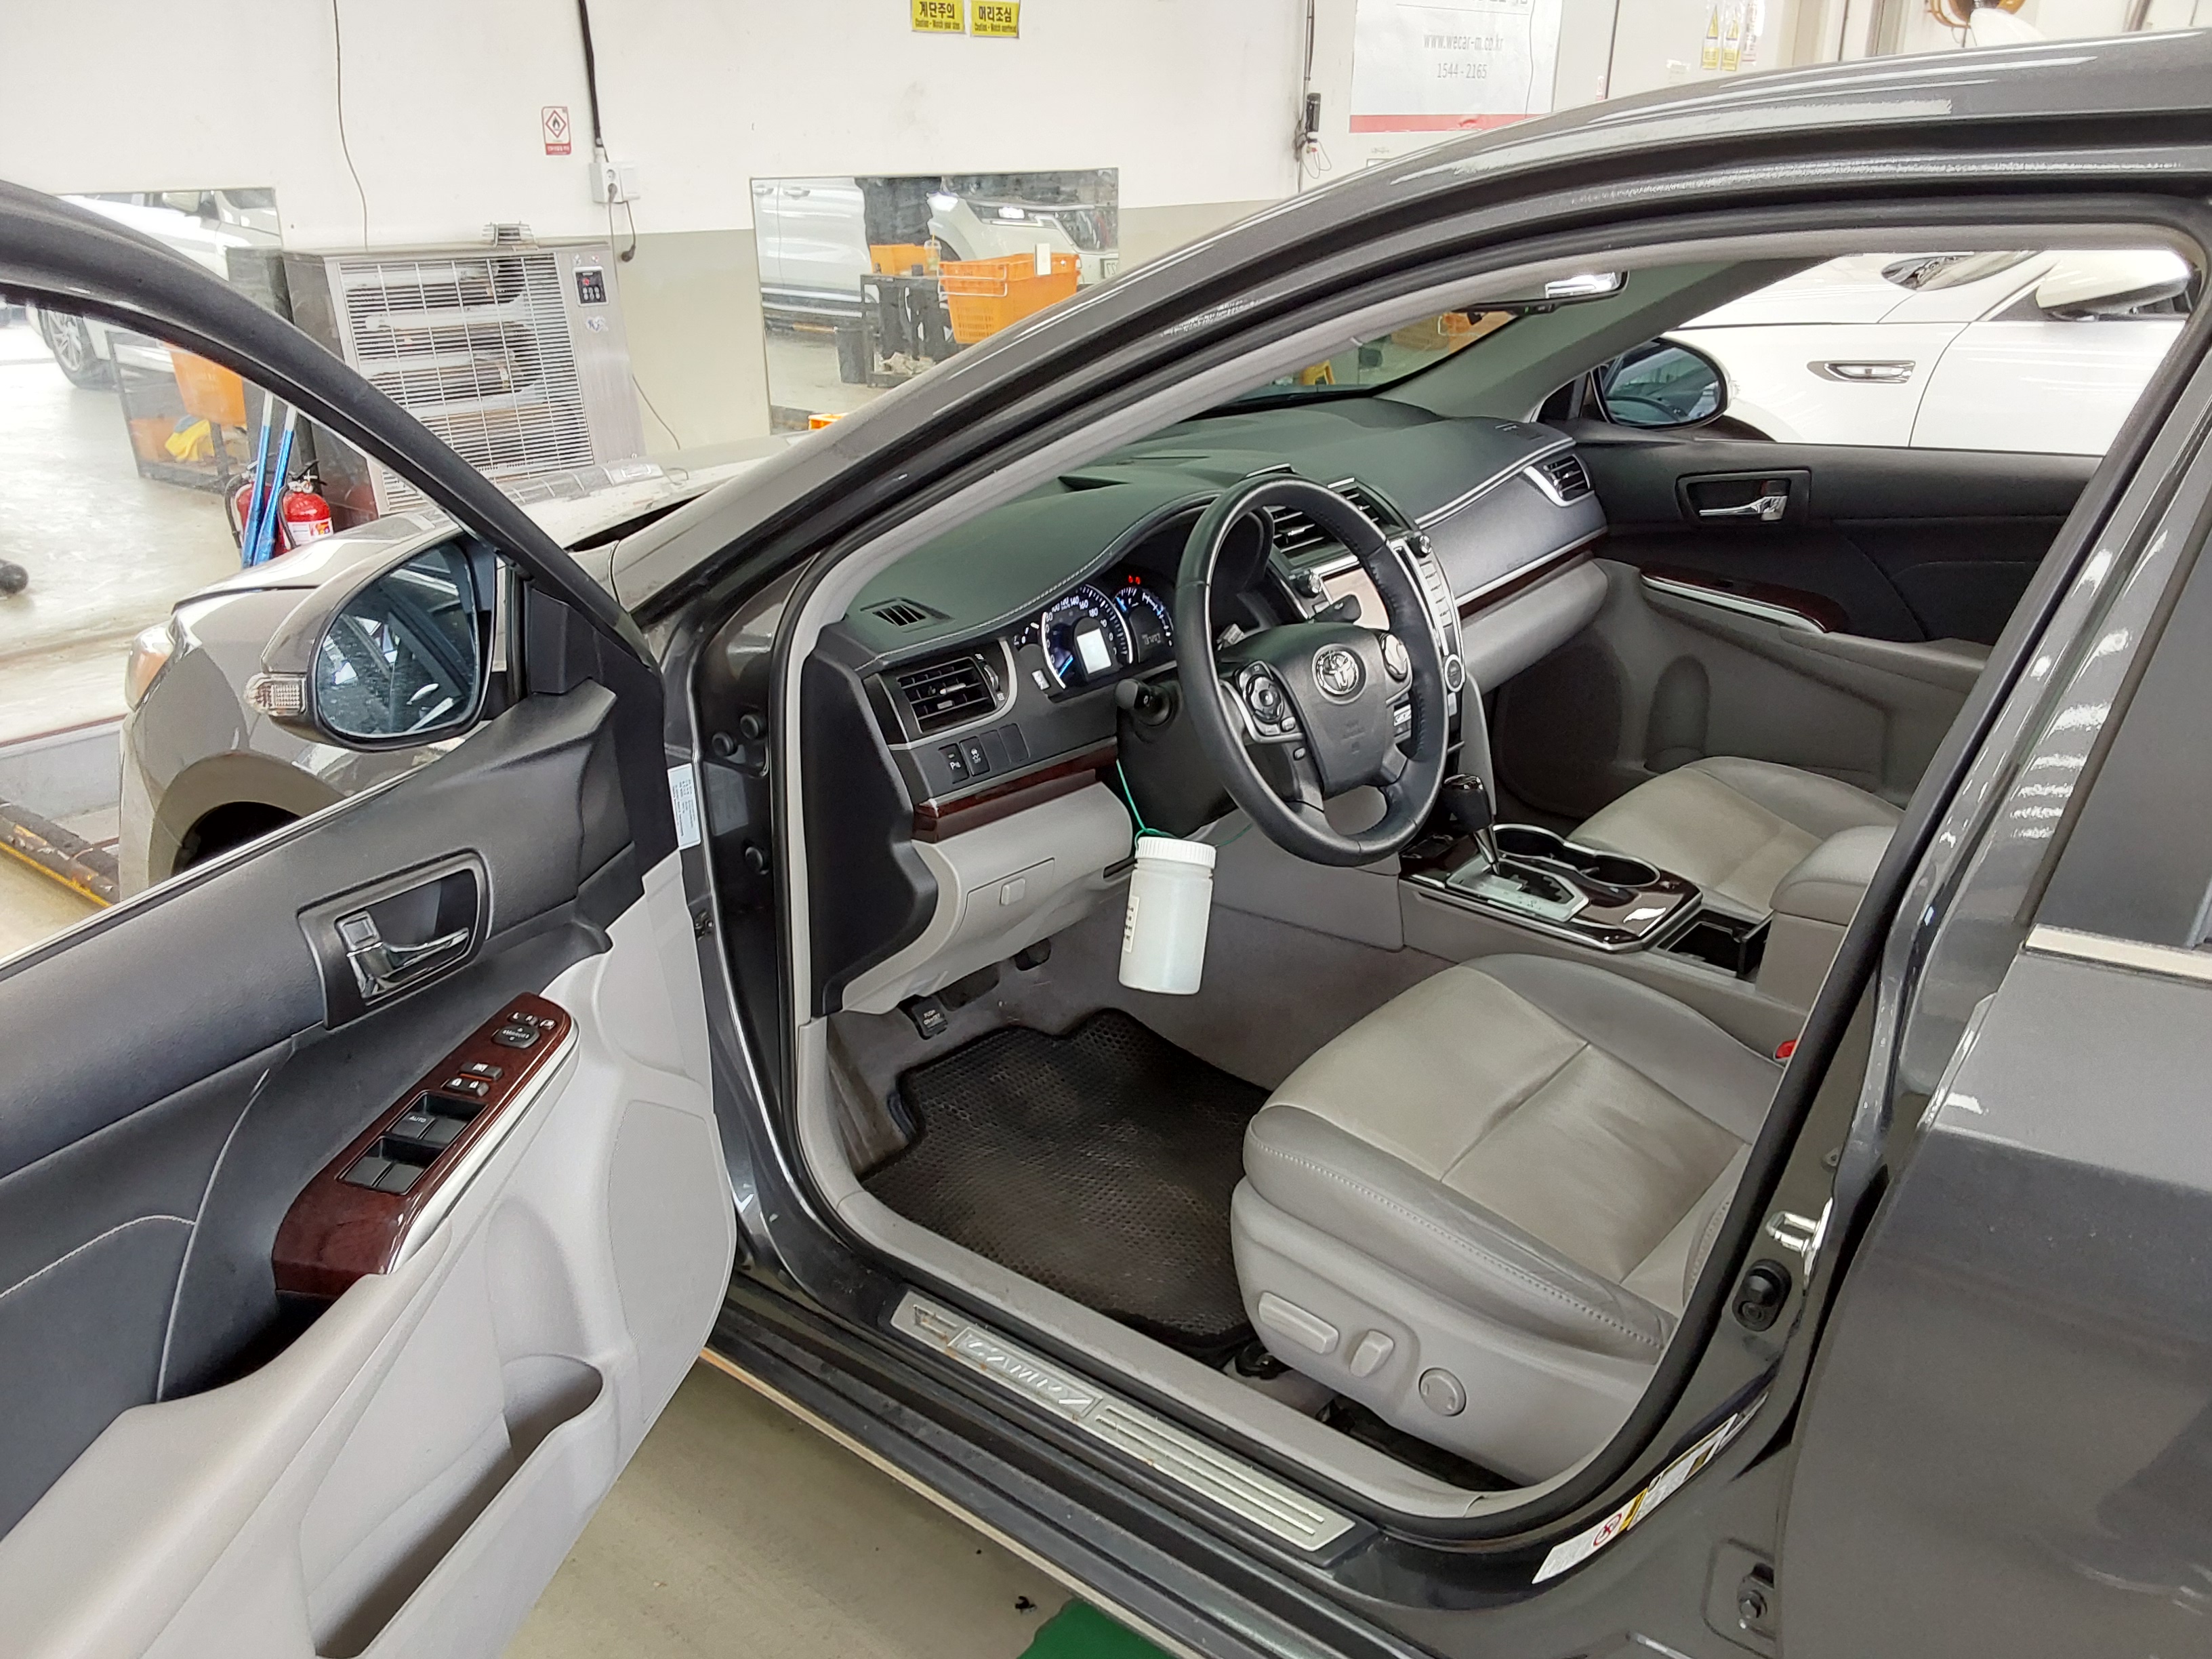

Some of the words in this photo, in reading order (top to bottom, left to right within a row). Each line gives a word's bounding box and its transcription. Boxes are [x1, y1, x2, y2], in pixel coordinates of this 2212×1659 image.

[919, 1, 955, 19] 계단주의
[979, 5, 1012, 22] 머리조심
[1424, 35, 1504, 51] www.wecar-m.co.kr
